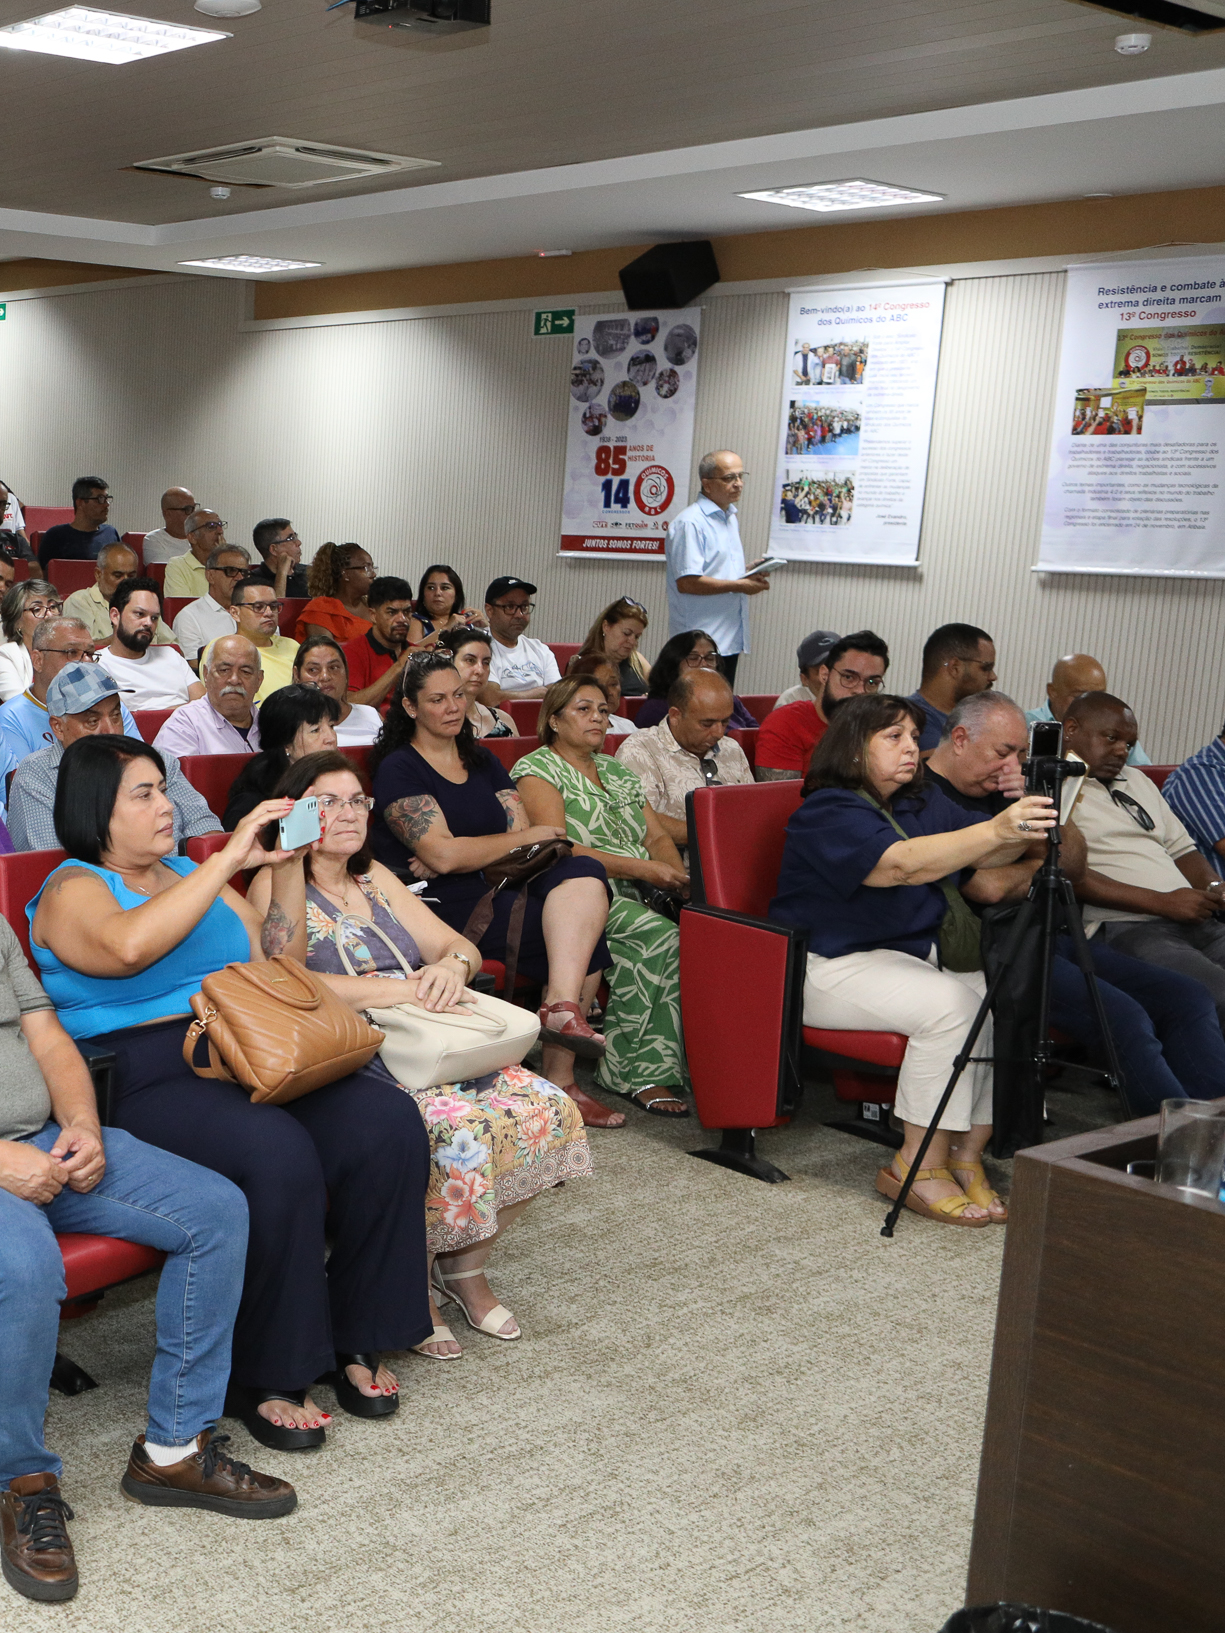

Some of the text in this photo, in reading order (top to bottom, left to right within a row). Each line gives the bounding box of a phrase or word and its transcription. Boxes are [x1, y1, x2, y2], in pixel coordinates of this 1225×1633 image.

[1098, 284, 1158, 296] Resistência
[1170, 280, 1216, 292] combate
[800, 304, 854, 315] Bem-vindo(a)
[883, 302, 930, 312] Congresso
[1098, 294, 1222, 309] extrema direita marcam
[834, 316, 873, 325] Químicos
[875, 315, 886, 323] do
[889, 313, 908, 322] ABC
[1138, 310, 1196, 321] Congresso
[594, 445, 627, 476] 85
[601, 478, 630, 509] 14
[583, 539, 660, 550] JUNTOS SOMOS FORTES!
